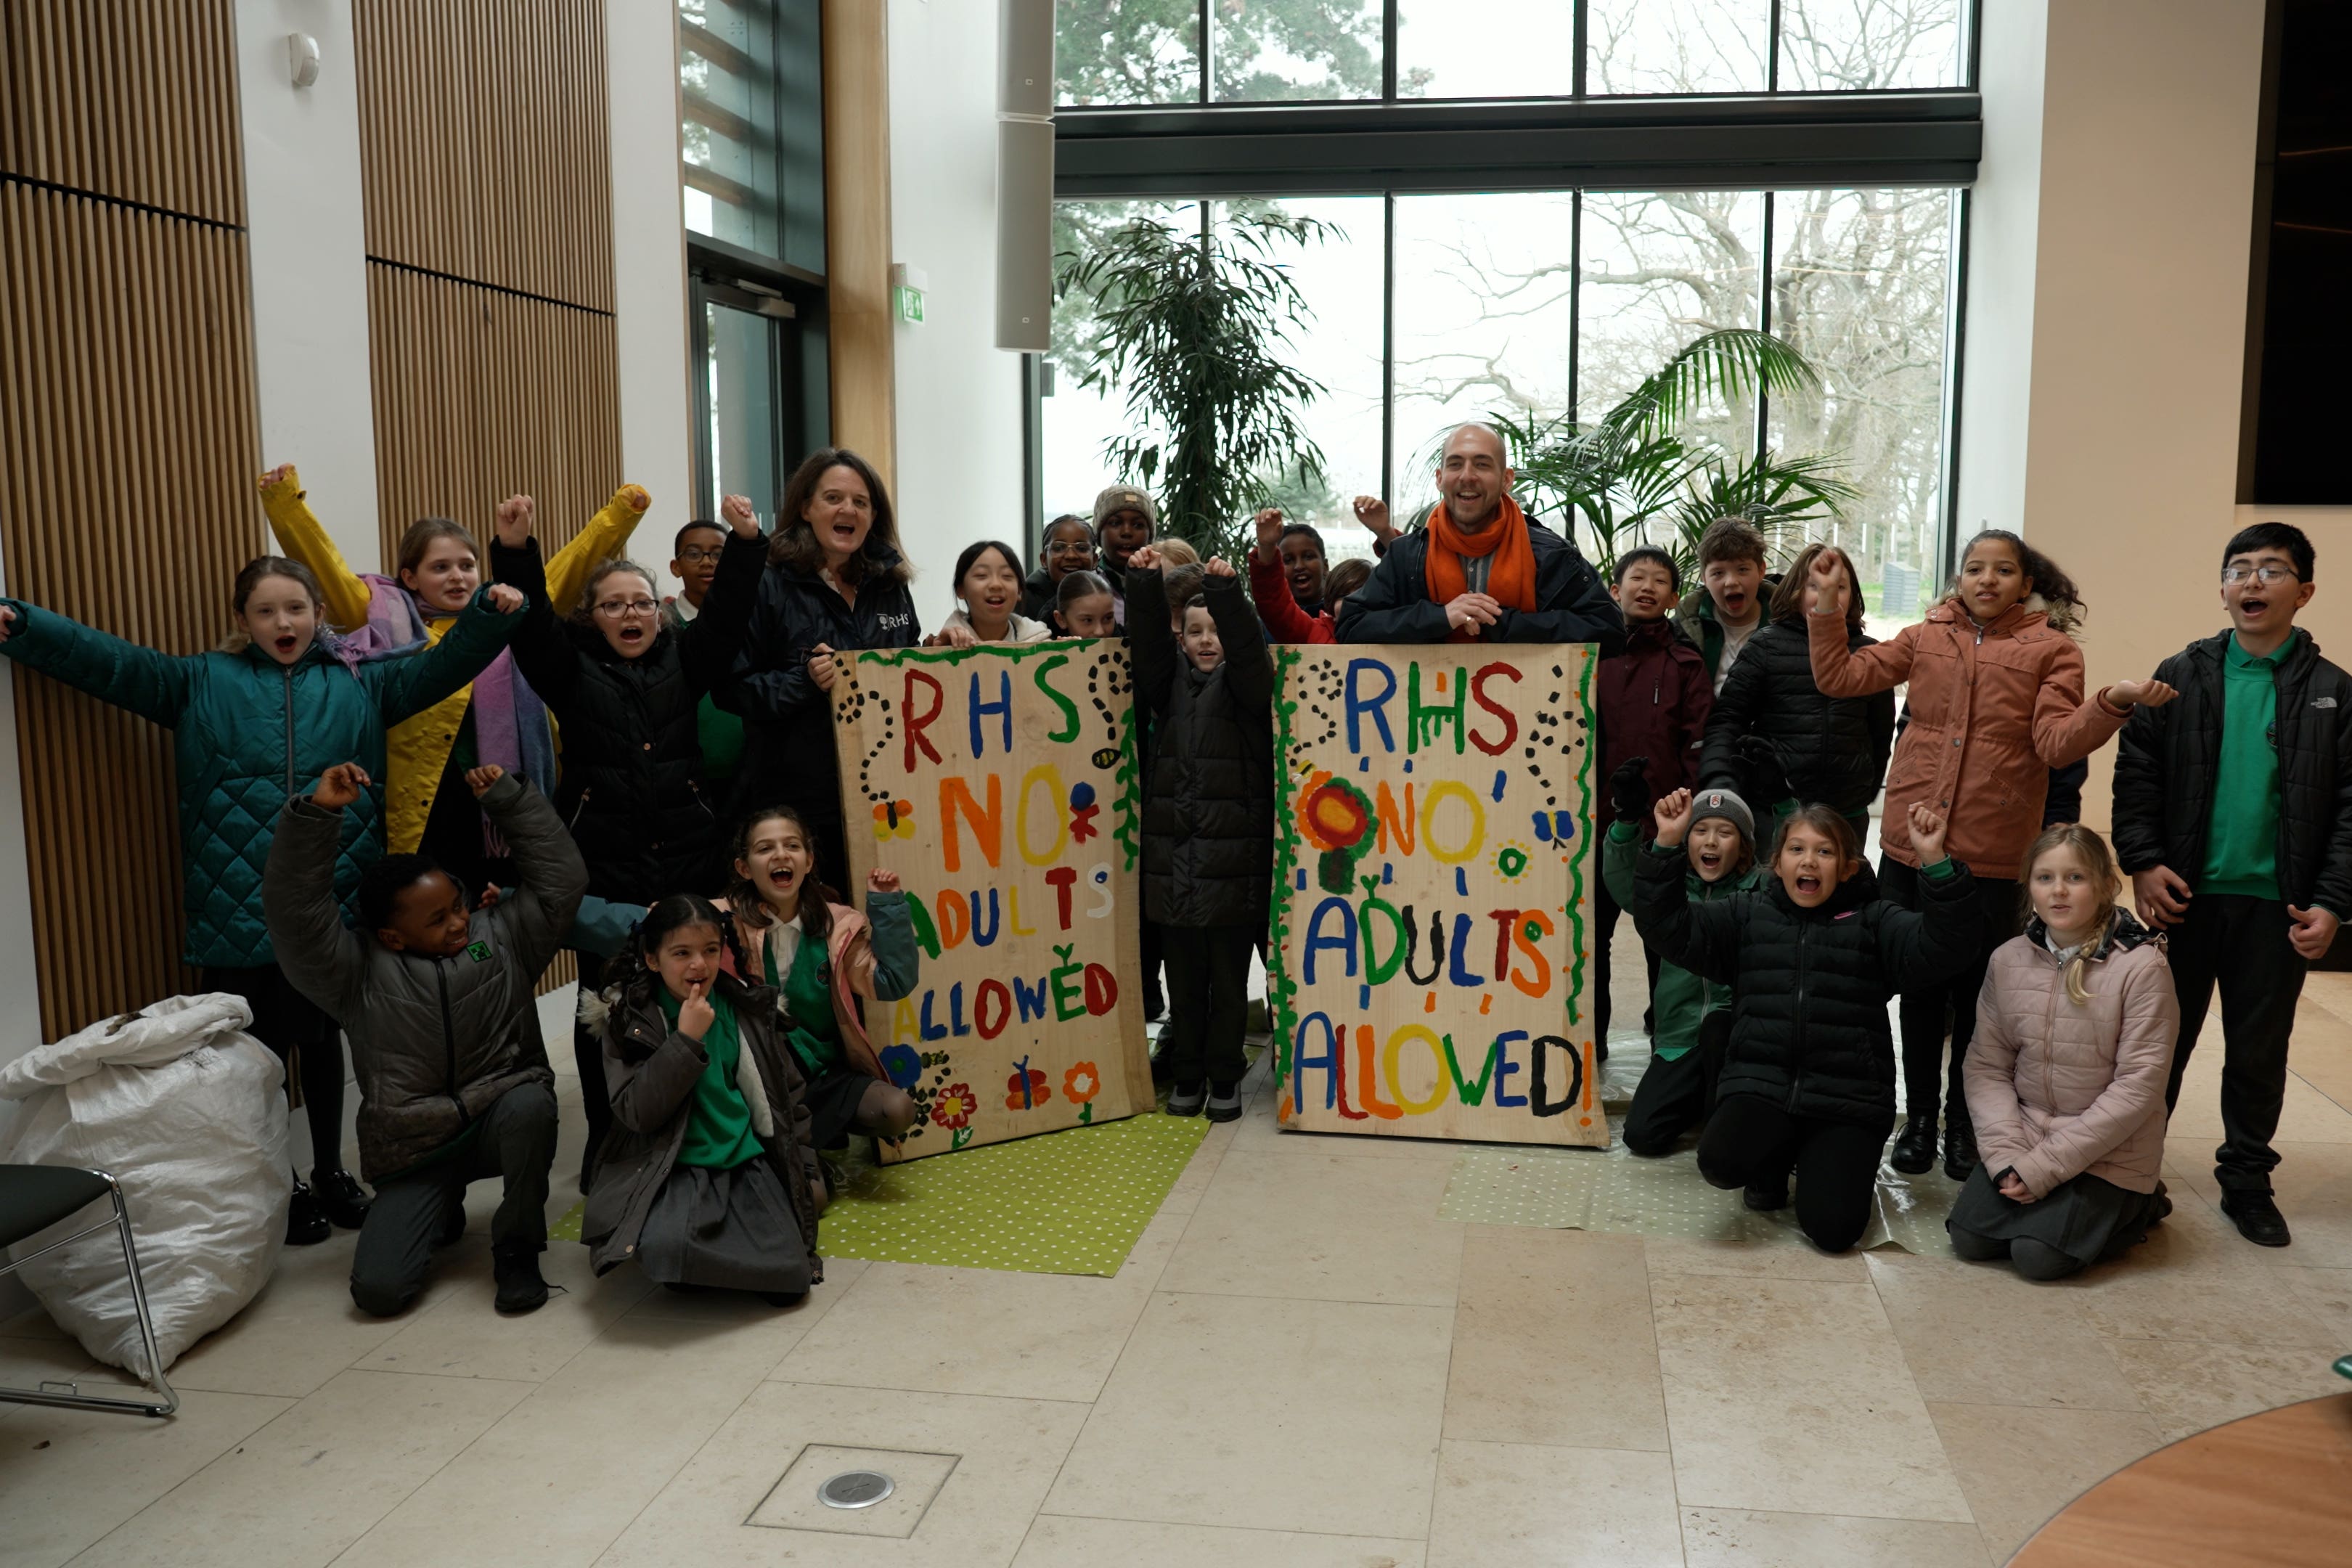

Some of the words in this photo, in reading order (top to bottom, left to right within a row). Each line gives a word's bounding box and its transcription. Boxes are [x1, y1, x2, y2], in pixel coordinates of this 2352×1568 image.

[889, 613, 909, 628] RHS
[901, 655, 1081, 773] RHS
[1344, 658, 1523, 756] RHS
[939, 762, 1069, 873] NO
[1376, 780, 1485, 865] NO
[1304, 897, 1554, 999] ADULTS
[893, 961, 1118, 1044] ALLOWED
[1294, 1011, 1593, 1127] ALLOWED!
